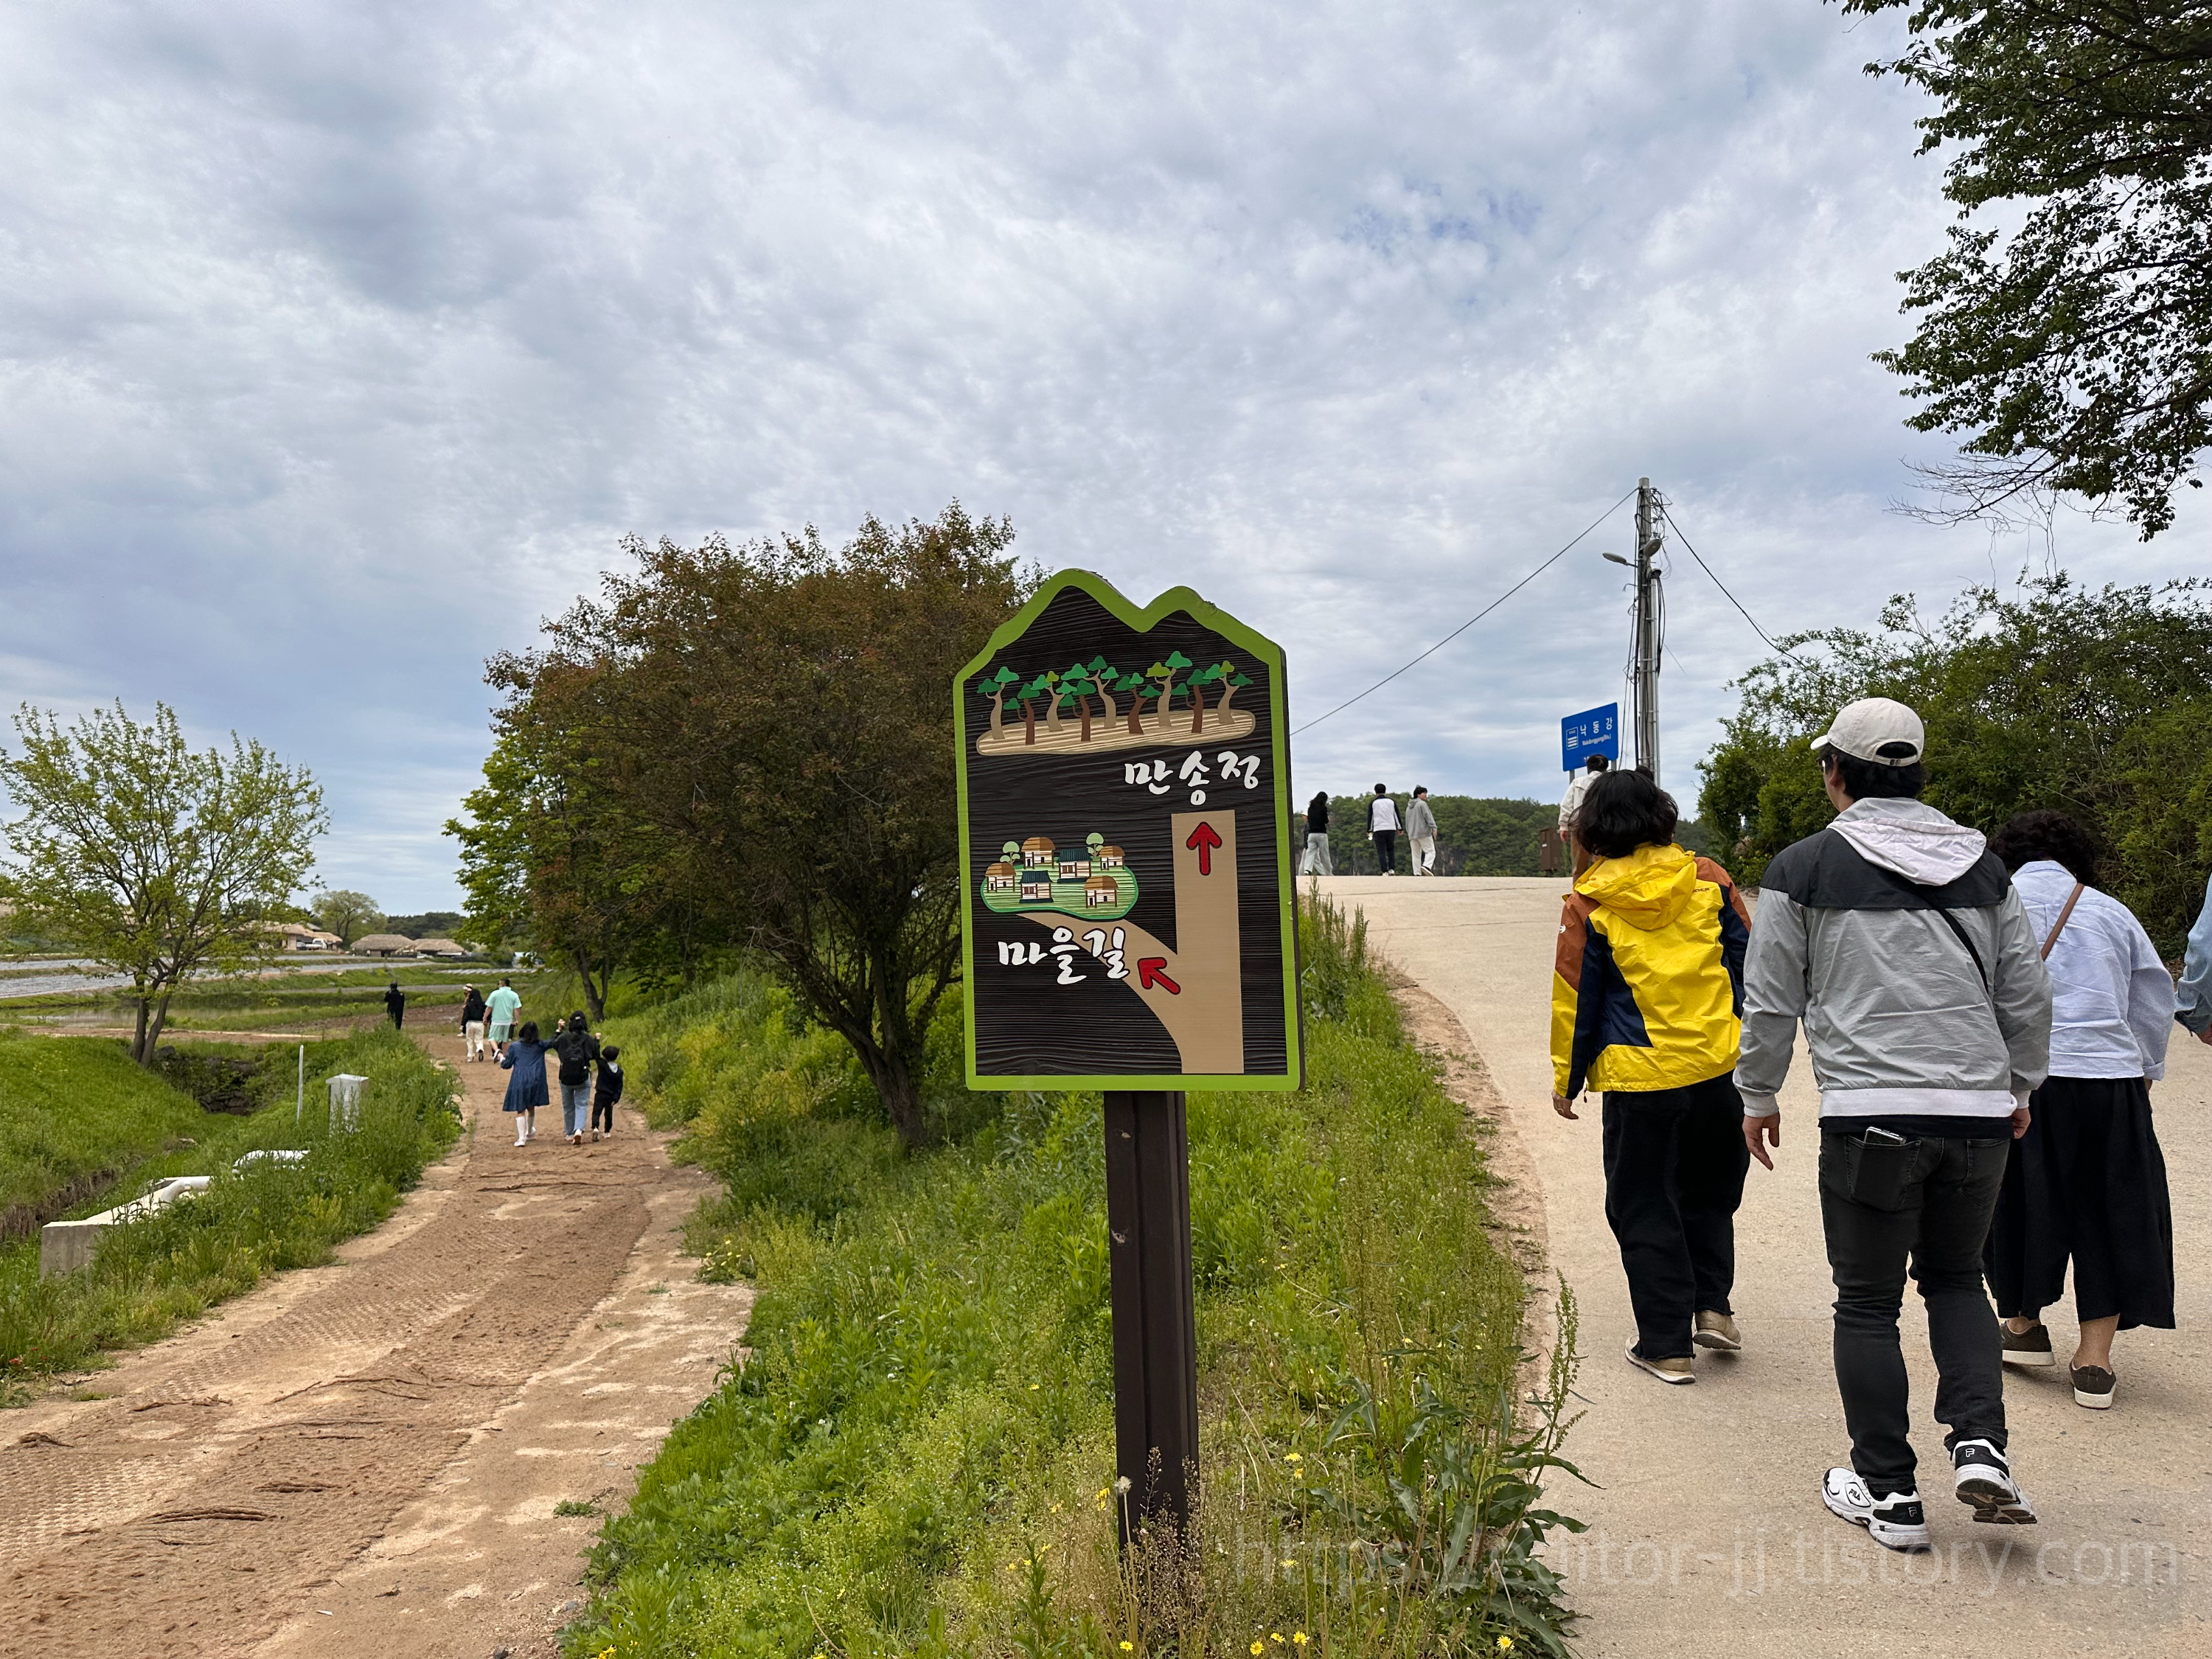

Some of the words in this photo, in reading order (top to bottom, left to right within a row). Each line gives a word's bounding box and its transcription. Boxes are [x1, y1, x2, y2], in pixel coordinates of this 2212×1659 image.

[1124, 751, 1261, 806] 만송정
[998, 926, 1130, 985] 마을길
[1848, 1488, 1860, 1501] FILA
